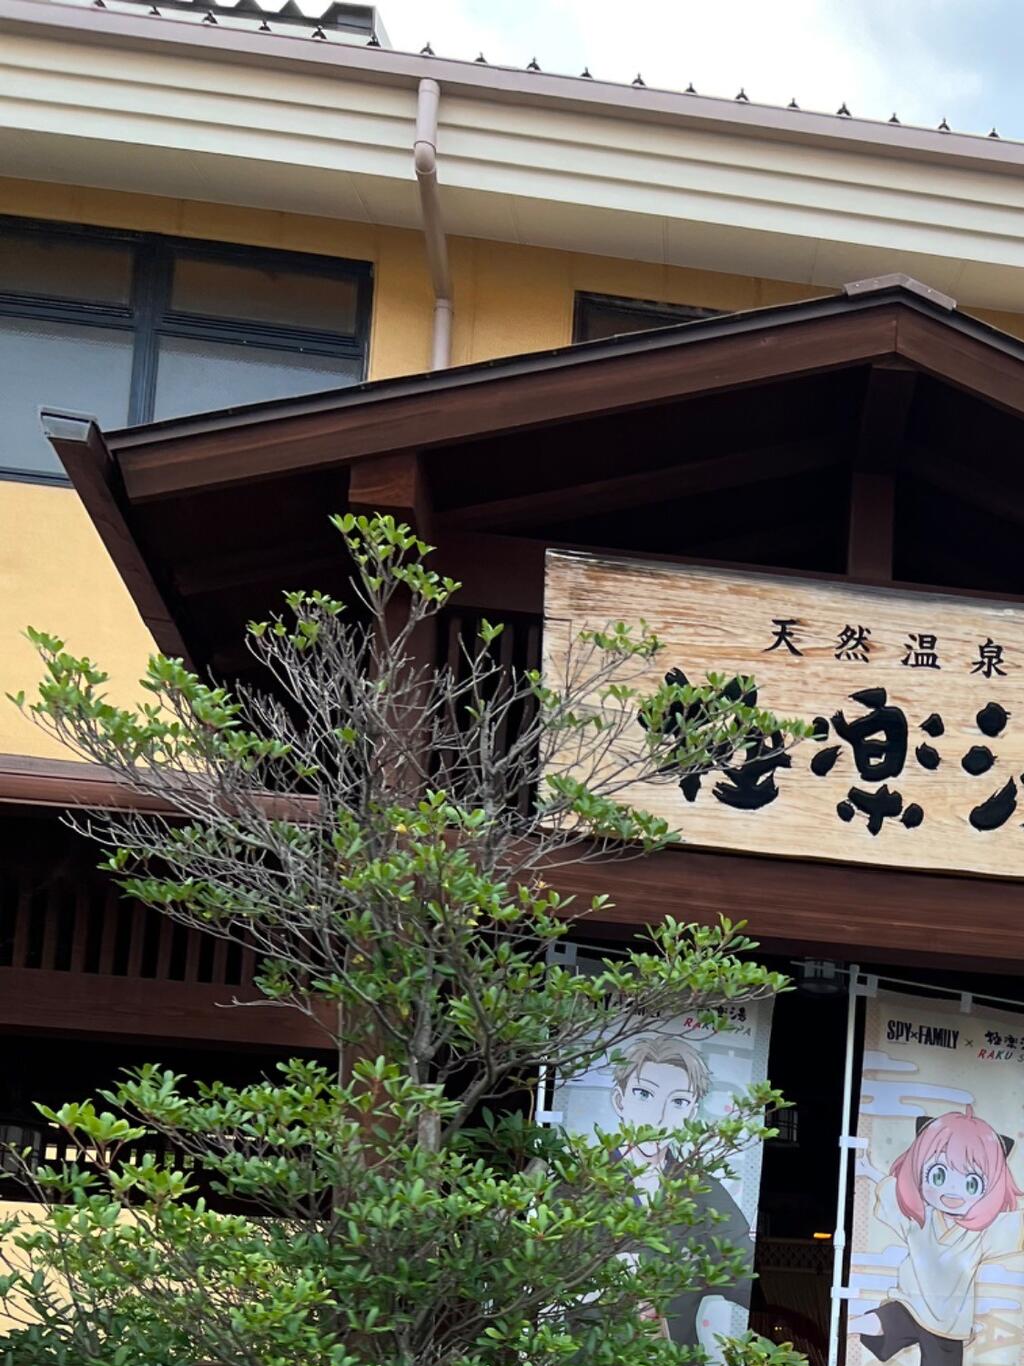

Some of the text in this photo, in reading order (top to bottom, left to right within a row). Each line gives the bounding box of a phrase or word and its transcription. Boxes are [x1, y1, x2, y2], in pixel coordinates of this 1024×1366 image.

[762, 618, 1007, 679] 天然温泉
[977, 1048, 1013, 1060] RAKU
